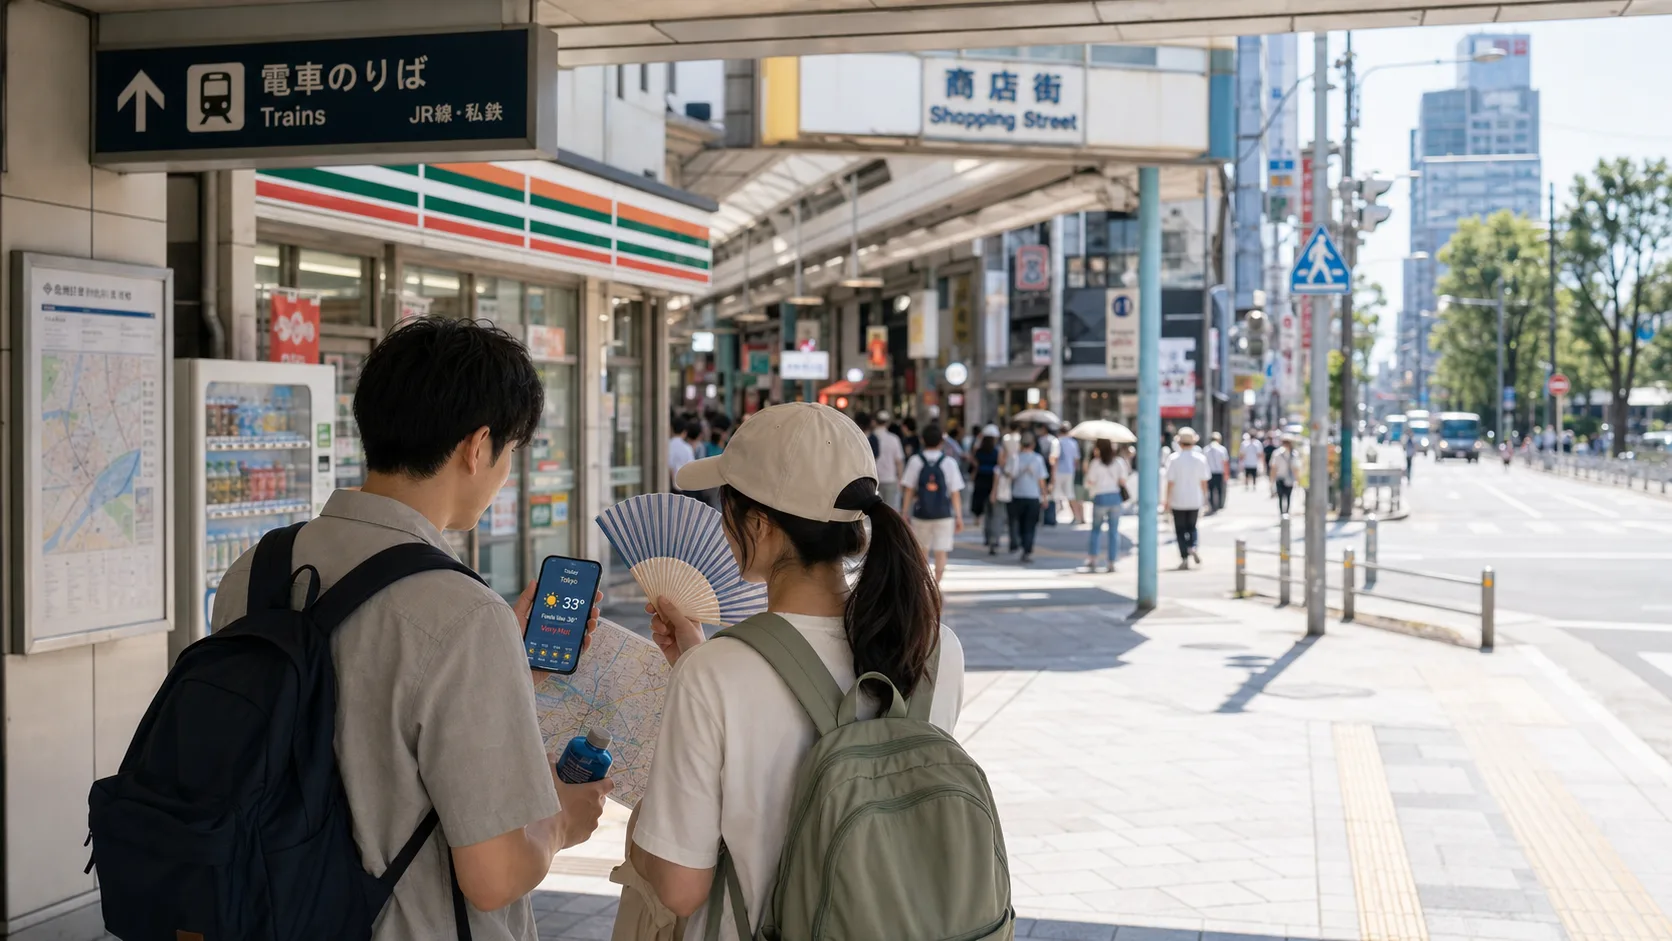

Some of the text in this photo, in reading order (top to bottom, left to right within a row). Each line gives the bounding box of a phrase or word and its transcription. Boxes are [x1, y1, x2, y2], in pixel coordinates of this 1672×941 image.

[261, 55, 429, 97] 電車のりば
[946, 67, 1062, 104] 商店街
[260, 105, 326, 128] Trains
[930, 106, 1077, 131] Shopping Street
[562, 596, 585, 610] 33°
